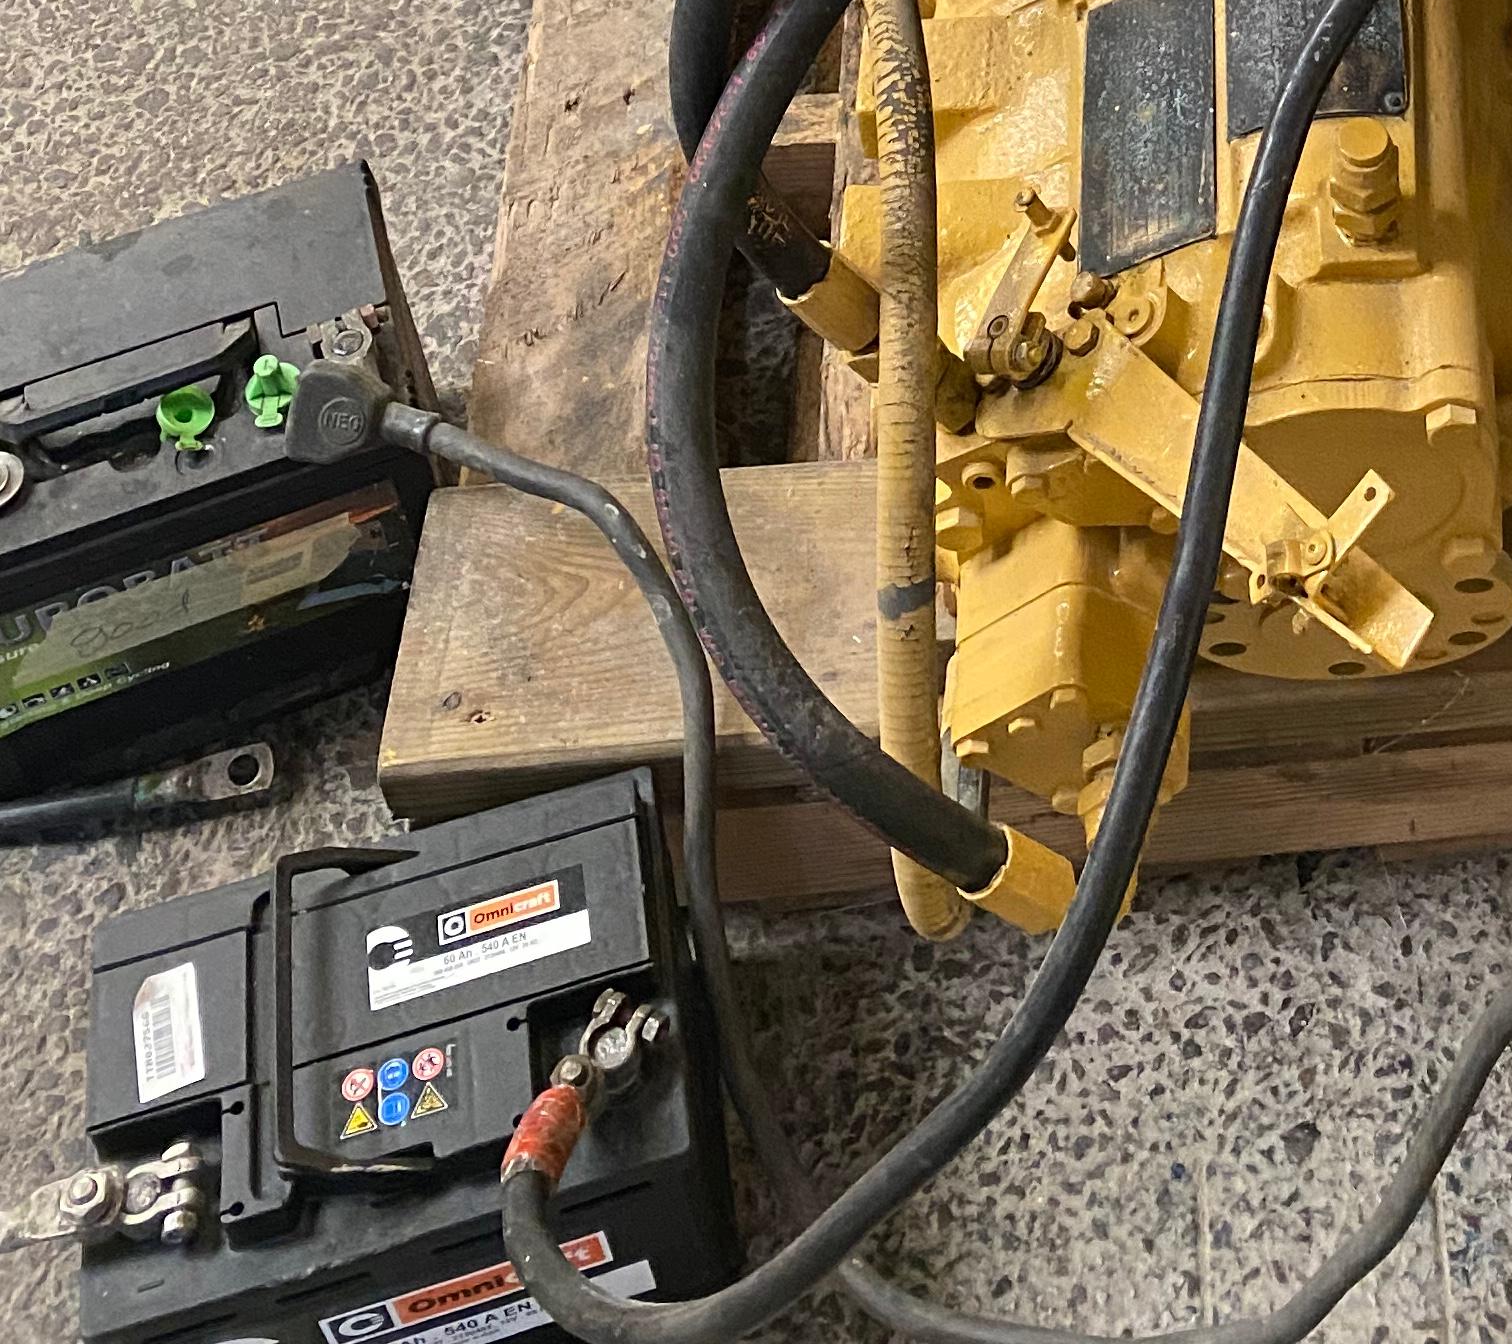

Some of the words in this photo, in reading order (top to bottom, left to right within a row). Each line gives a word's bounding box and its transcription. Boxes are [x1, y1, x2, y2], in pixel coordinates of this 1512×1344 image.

[473, 890, 553, 924] Omnicraft
[444, 1318, 479, 1337] 540
[485, 1313, 499, 1325] A
[504, 1300, 533, 1318] EN
